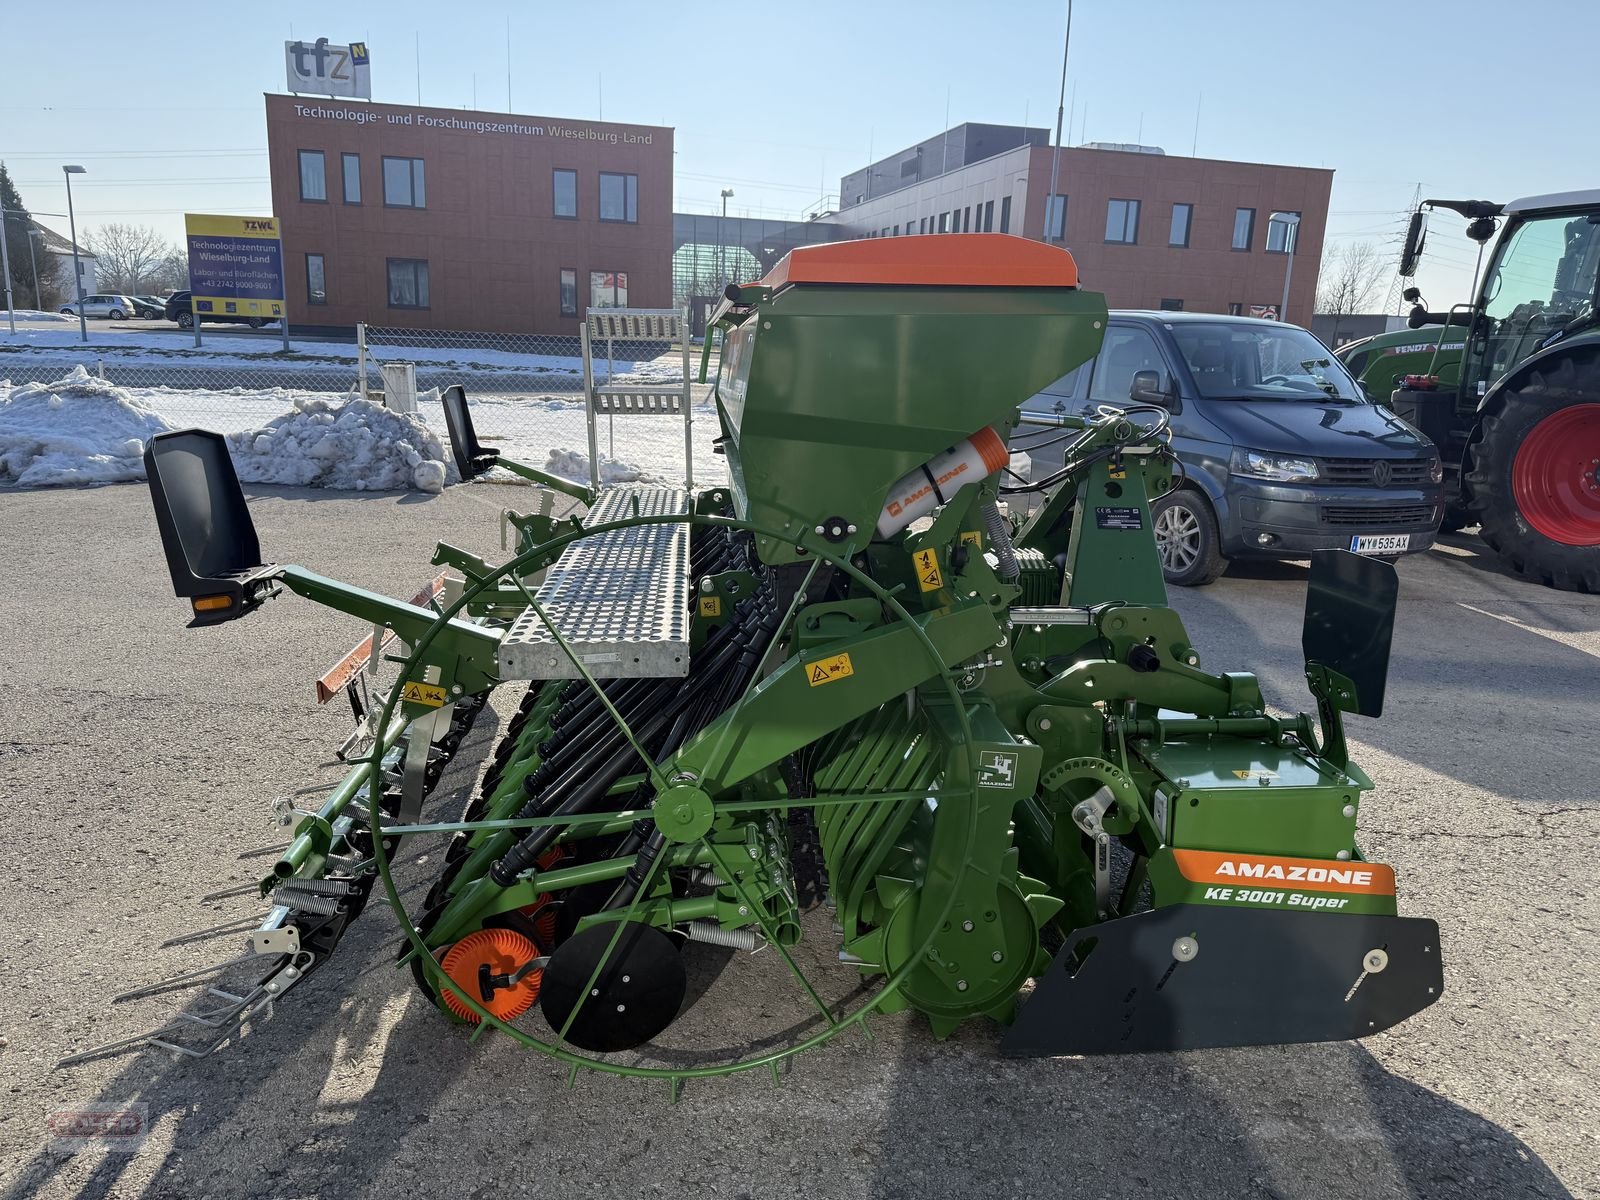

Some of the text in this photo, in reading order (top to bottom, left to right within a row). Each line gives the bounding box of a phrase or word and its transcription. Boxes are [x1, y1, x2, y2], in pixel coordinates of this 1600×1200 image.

[289, 37, 350, 80] tfz
[294, 104, 653, 145] Technologie- und Forschungszentrum Wieselburg-Land
[191, 240, 277, 253] Technologiezentrum
[199, 252, 270, 264] Wieselburg-Land
[218, 270, 233, 278] und
[1395, 343, 1430, 354] FENDT
[1359, 536, 1408, 550] WY 535 AX
[1215, 861, 1373, 886] AMAZONE
[1204, 887, 1349, 910] KE 3001 Super
